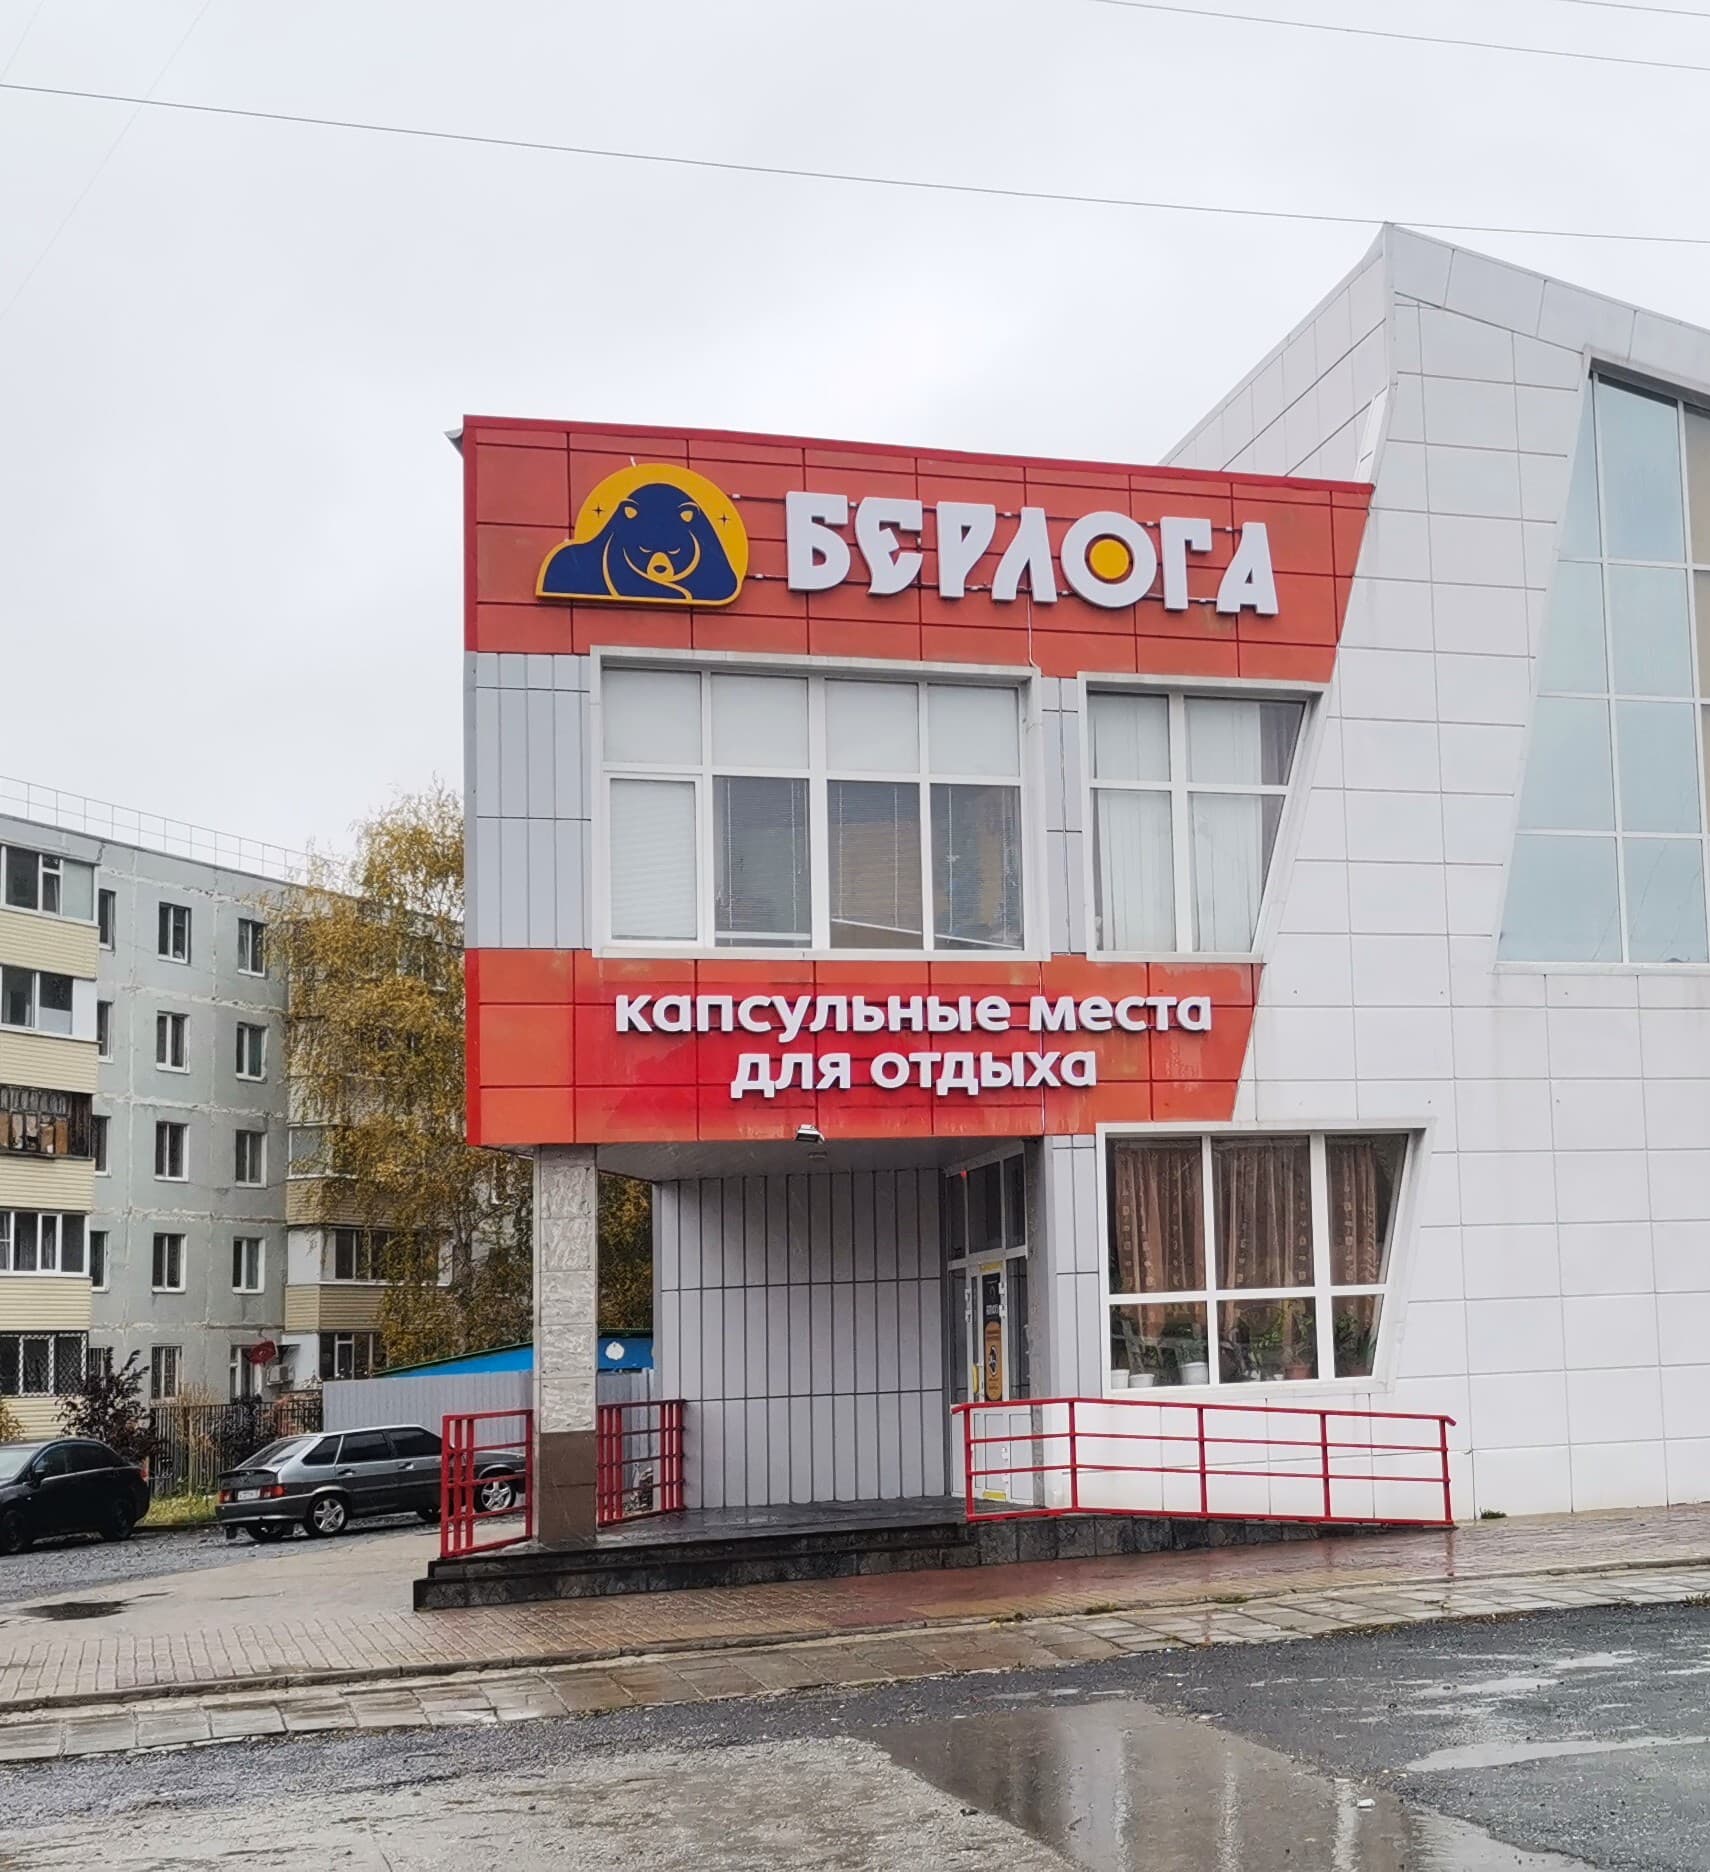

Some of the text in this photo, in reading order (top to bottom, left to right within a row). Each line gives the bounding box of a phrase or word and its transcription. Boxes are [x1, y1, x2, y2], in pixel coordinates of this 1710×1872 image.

[785, 490, 1279, 615] БЕРЛОГА
[615, 994, 1212, 1043] капсульные места
[730, 1050, 1097, 1099] для отдыха
